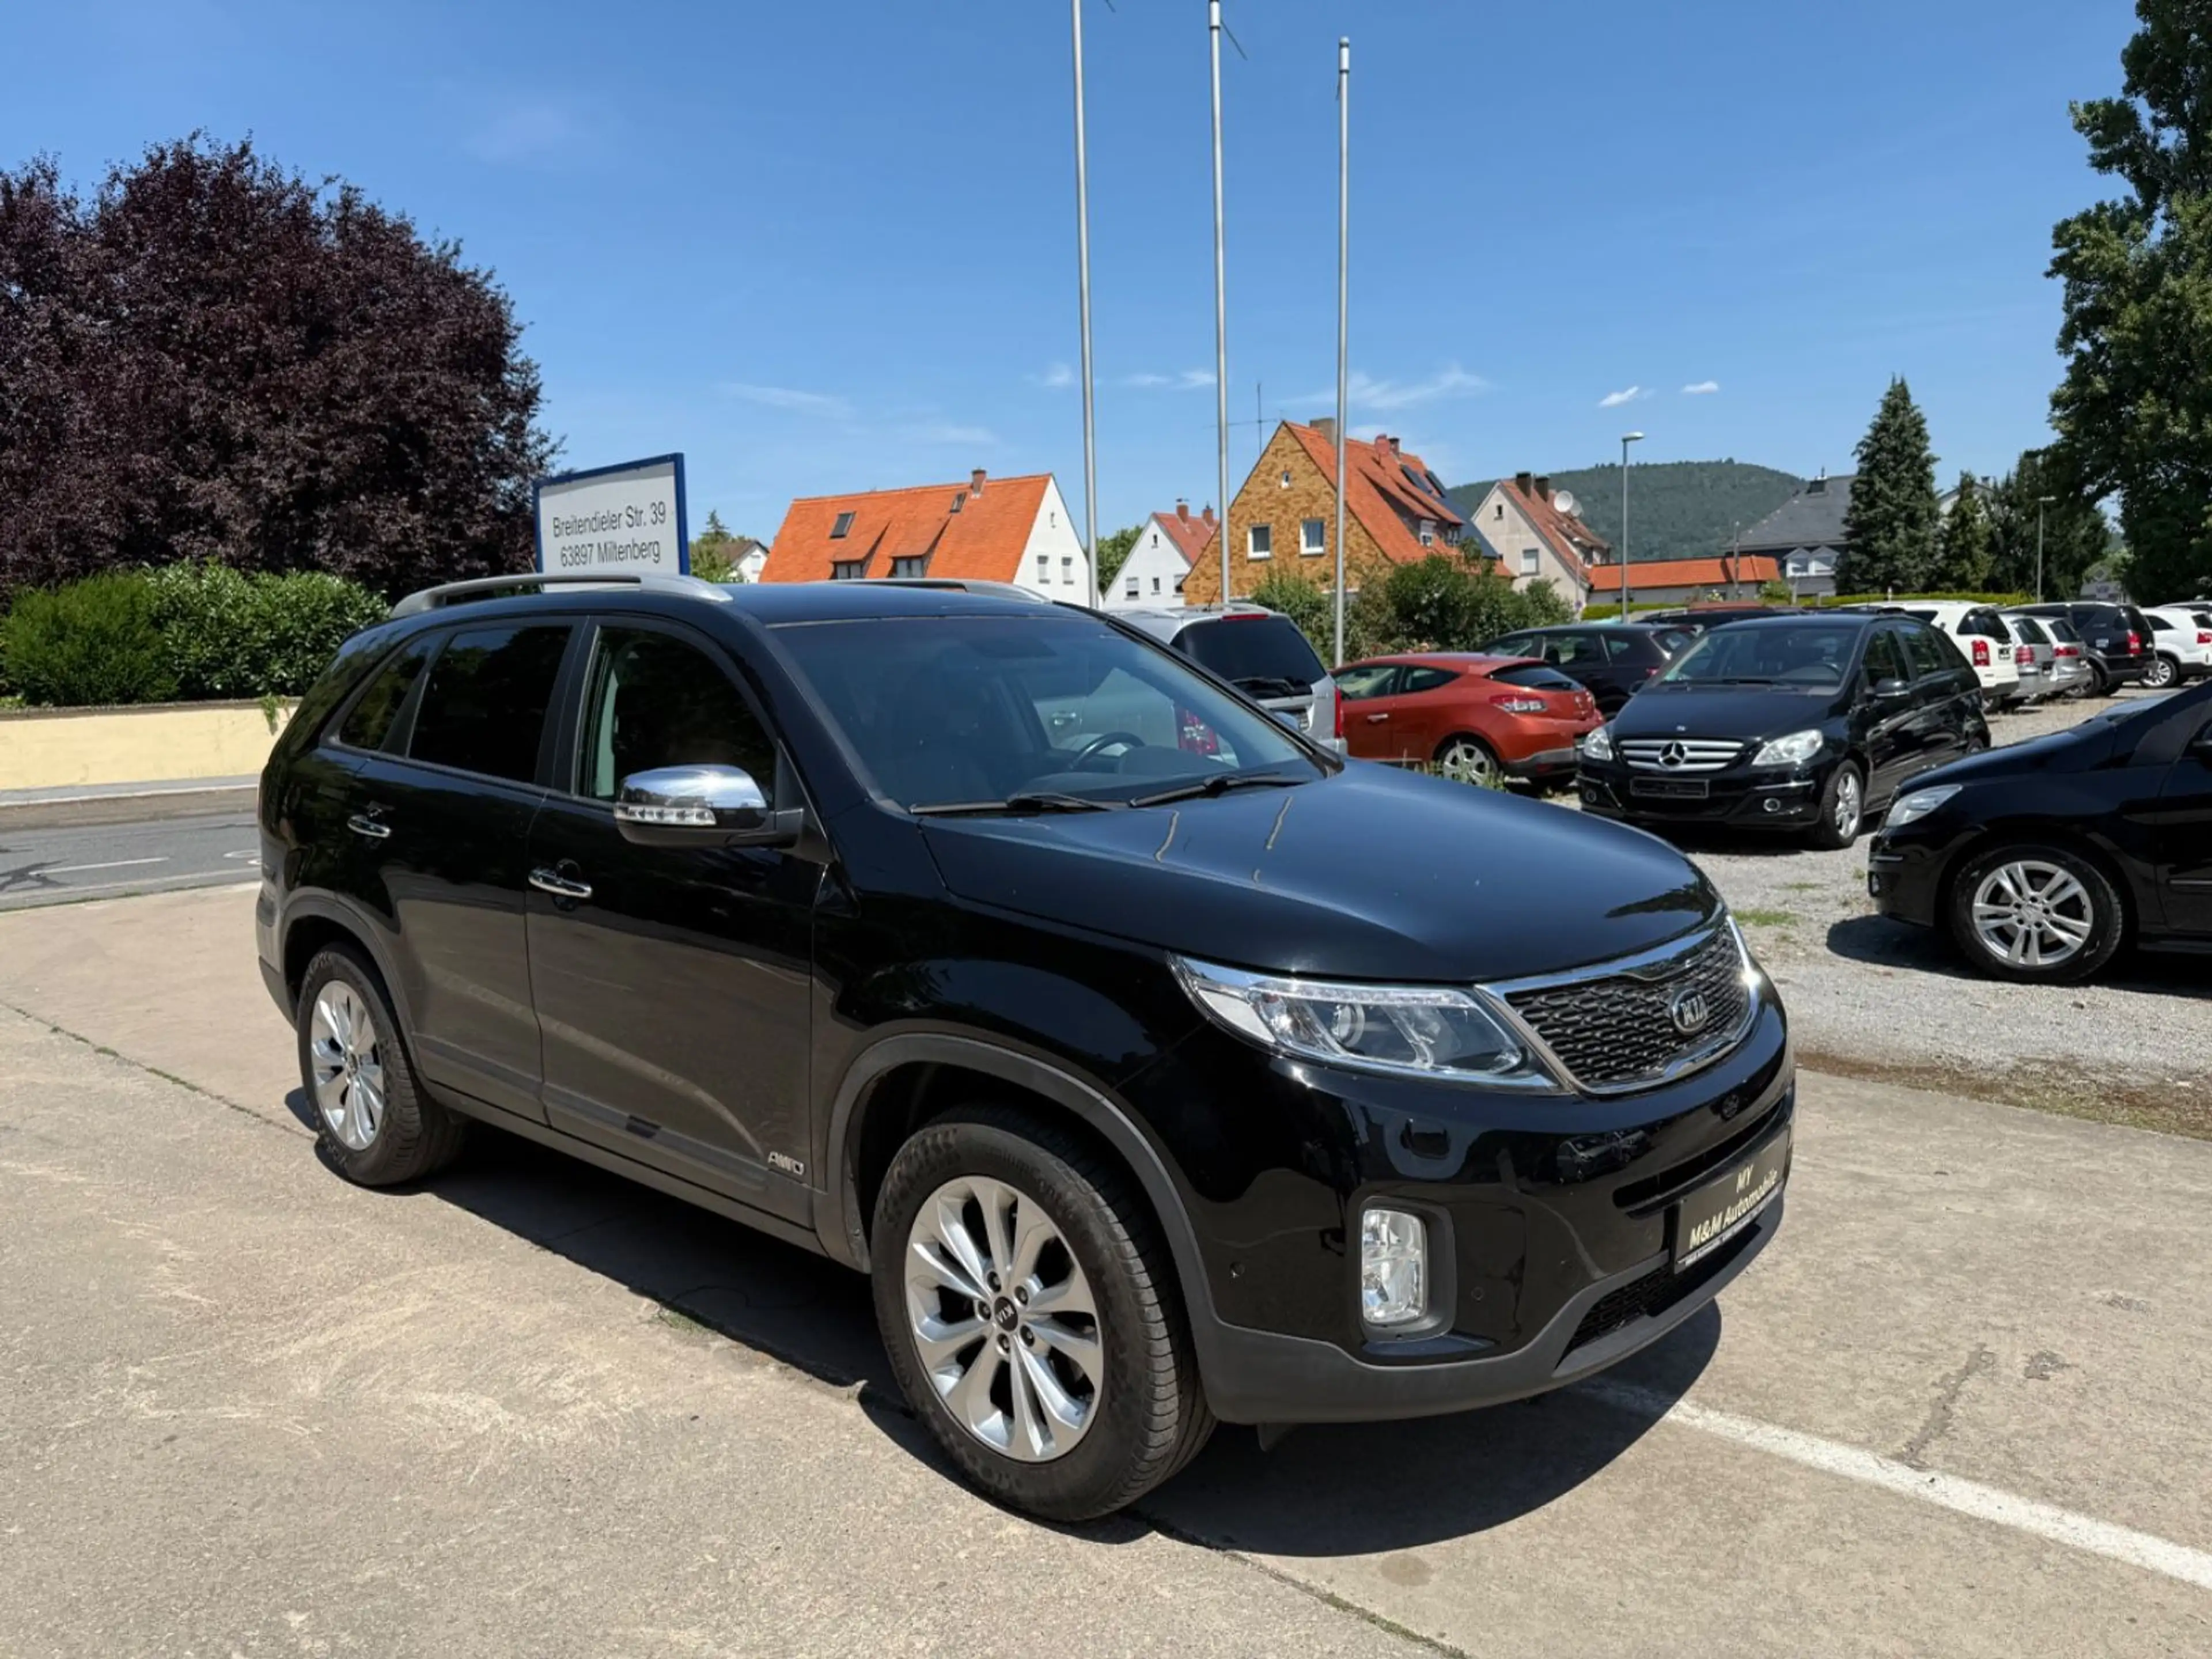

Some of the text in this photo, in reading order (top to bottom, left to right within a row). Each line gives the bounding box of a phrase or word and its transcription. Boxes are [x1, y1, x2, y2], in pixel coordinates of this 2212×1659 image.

[553, 501, 665, 537] Breitendieler Str. 39
[560, 537, 660, 567] 63897 Miltenberg
[1681, 994, 1706, 1025] KIA
[768, 1151, 805, 1175] AWD
[1689, 1211, 1723, 1250] M&M
[996, 1304, 1014, 1324] KIA
